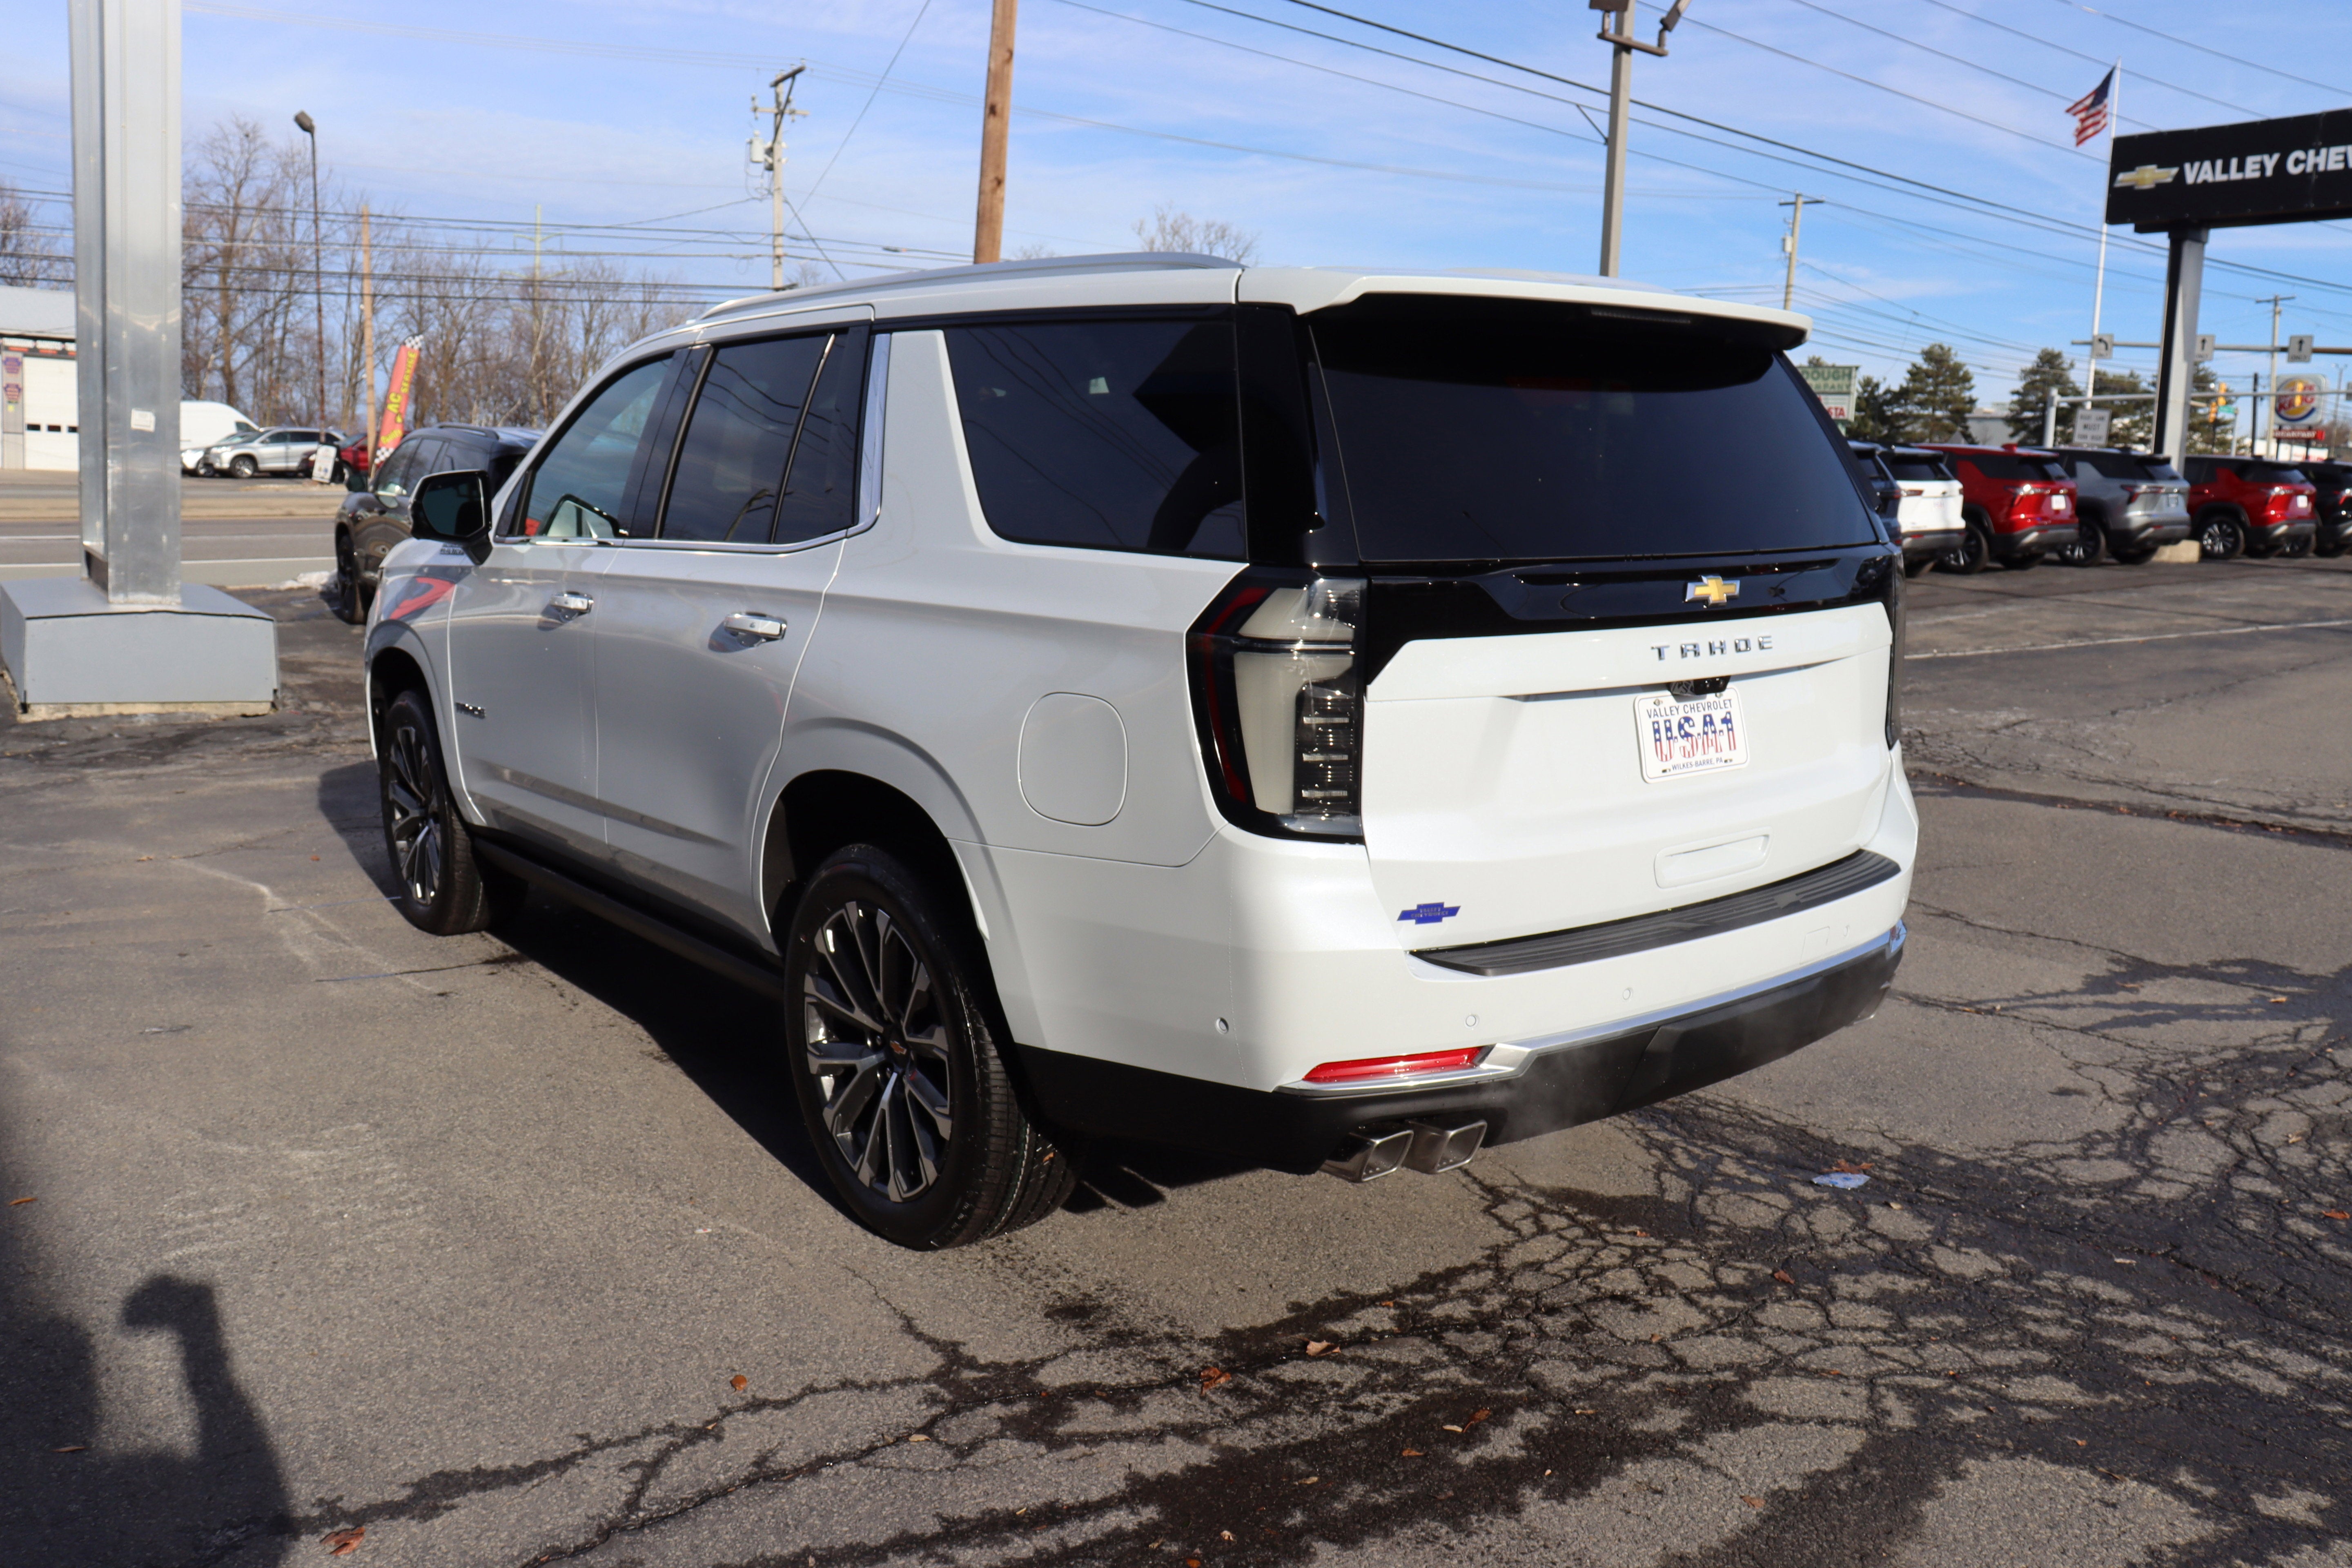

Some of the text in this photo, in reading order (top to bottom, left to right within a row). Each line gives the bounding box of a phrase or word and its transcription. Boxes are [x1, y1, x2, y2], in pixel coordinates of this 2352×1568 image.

[2183, 152, 2281, 185] VALLEY
[387, 392, 402, 414] AC
[401, 351, 417, 393] SERVICE
[1801, 368, 1852, 381] DOUGH
[1651, 635, 1773, 661] TAHOE
[1646, 699, 1732, 719] VALLEY CHEVROLET
[1672, 758, 1715, 771] WILKES-BARRE,
